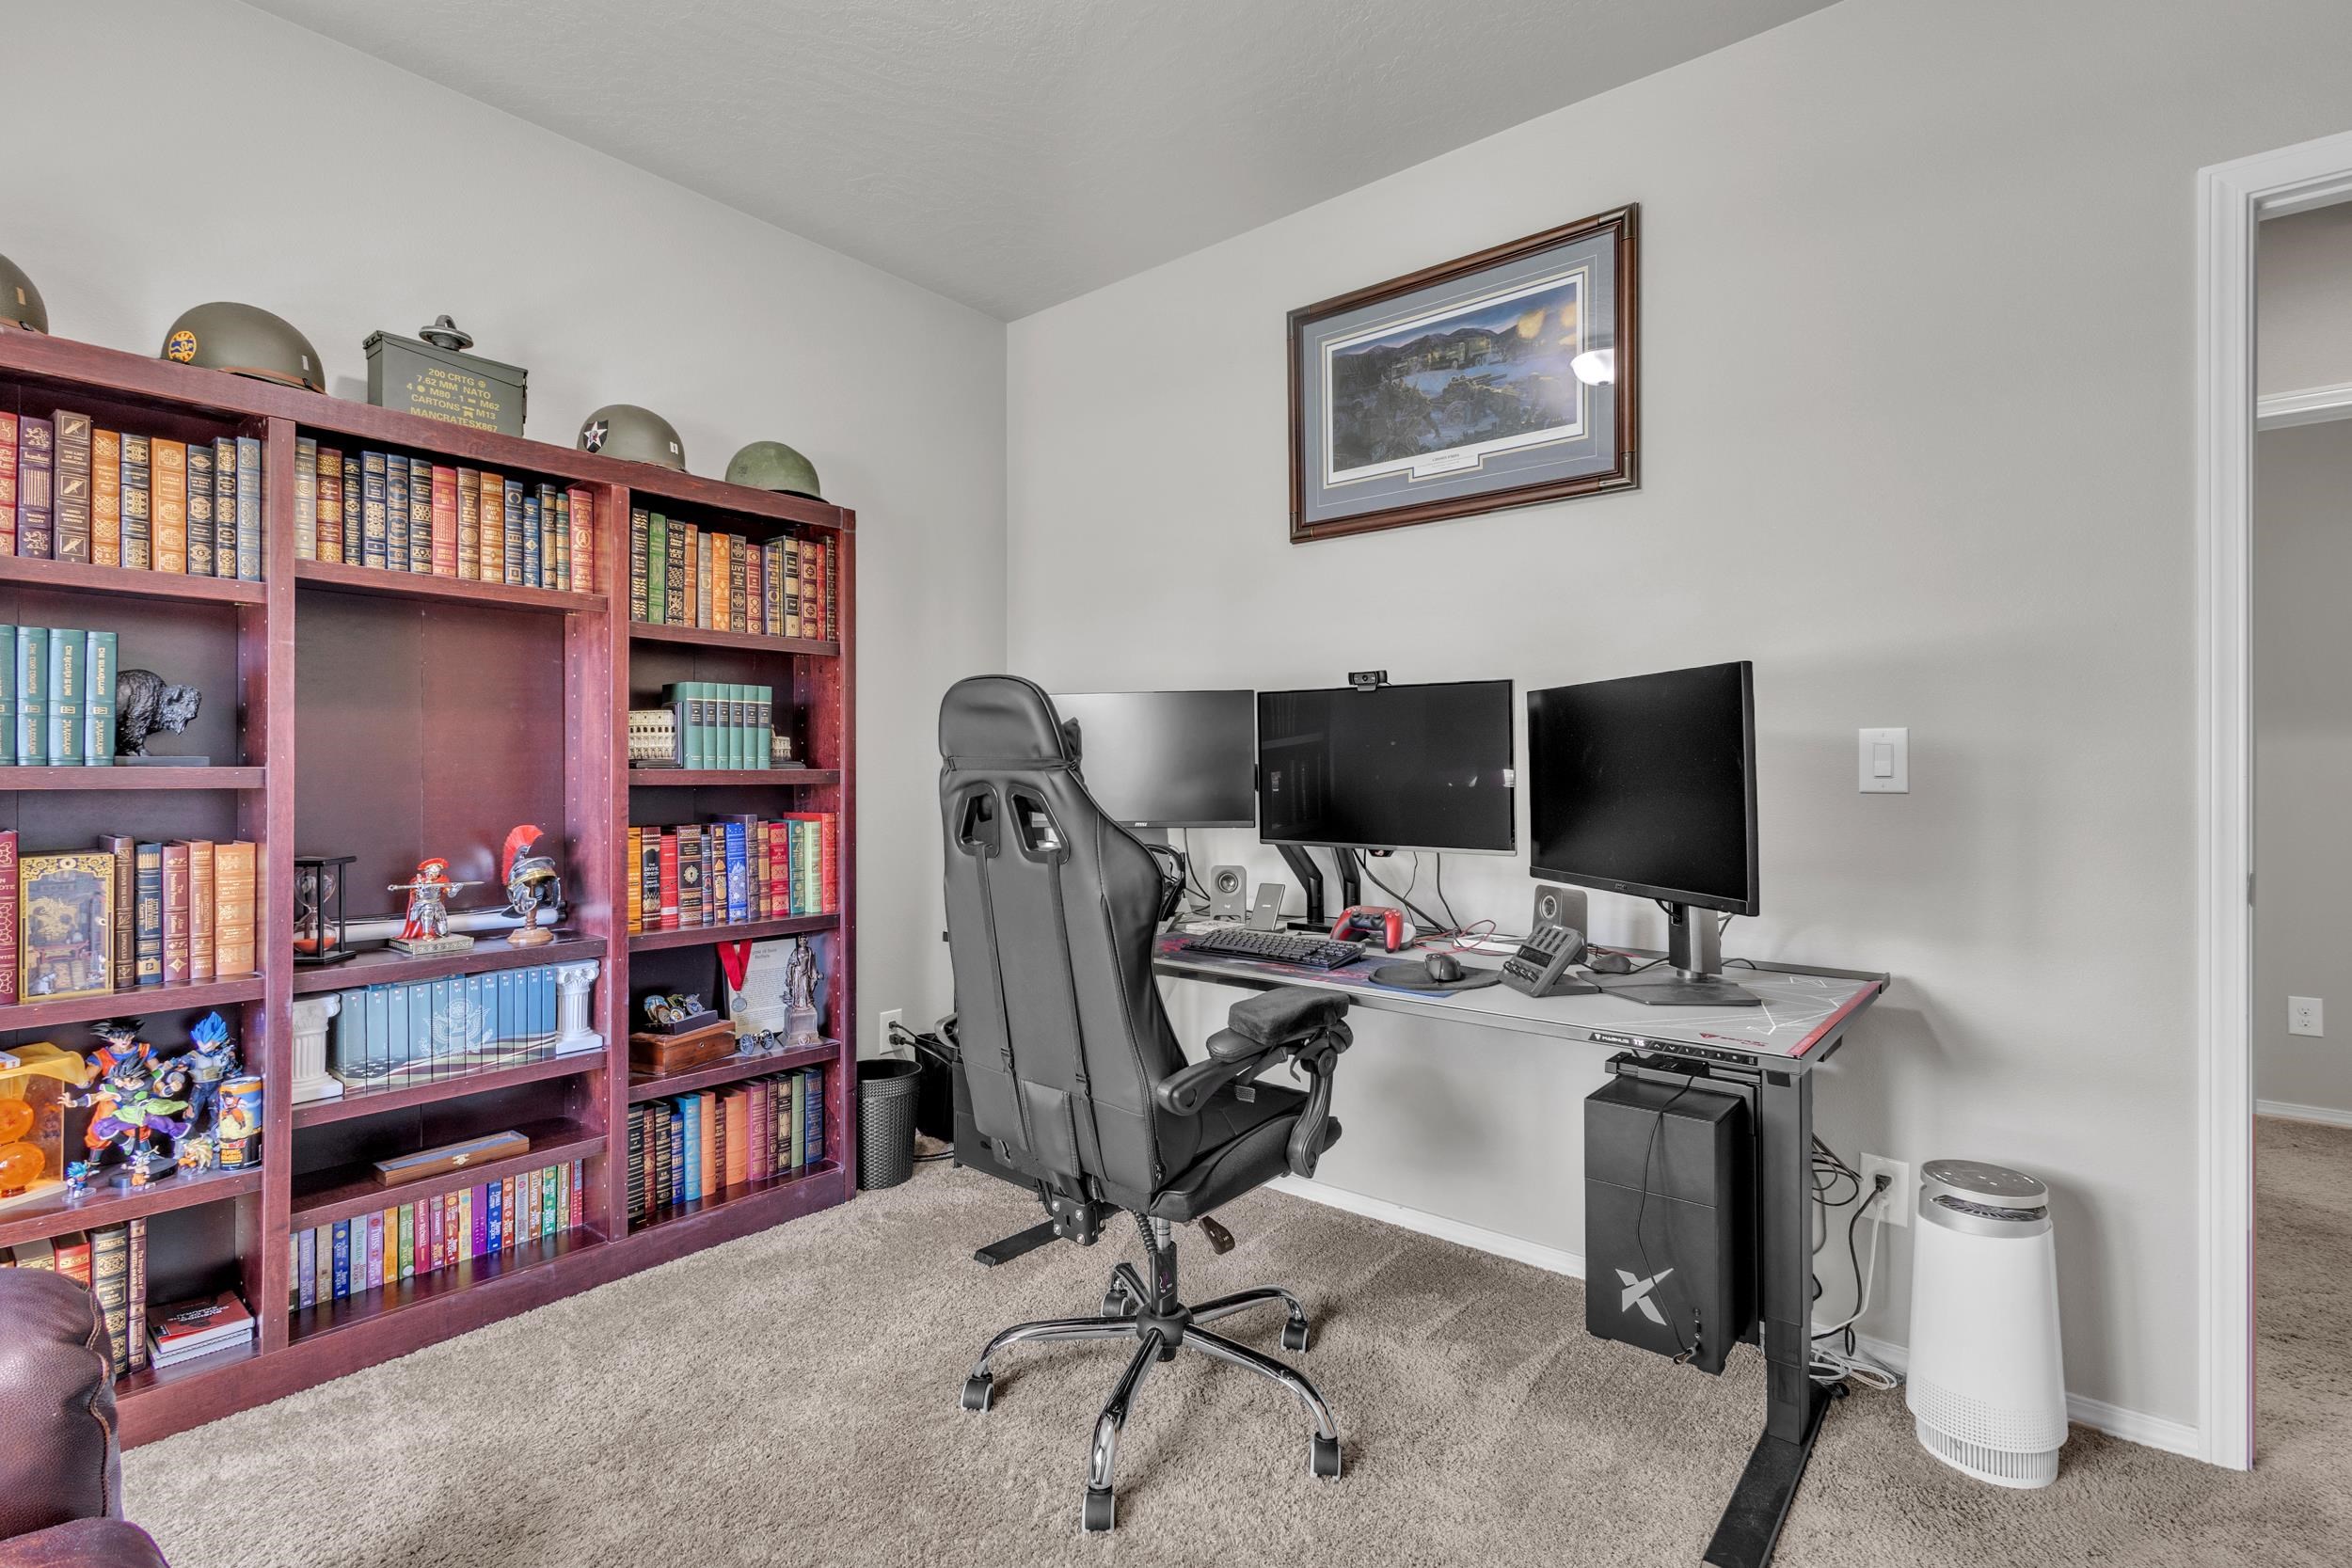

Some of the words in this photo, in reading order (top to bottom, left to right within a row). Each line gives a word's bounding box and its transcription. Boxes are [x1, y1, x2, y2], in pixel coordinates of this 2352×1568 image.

[417, 374, 437, 388] 7.62
[439, 381, 458, 392] MM
[463, 387, 491, 400] NATO
[428, 368, 446, 379] 200
[448, 372, 475, 386] CRTG
[406, 382, 413, 390] 4
[430, 388, 451, 400] M80
[480, 400, 501, 412] M62
[411, 394, 461, 412] CARTONS
[475, 408, 497, 420] M13
[1601, 1036, 1629, 1044] MAGNUS
